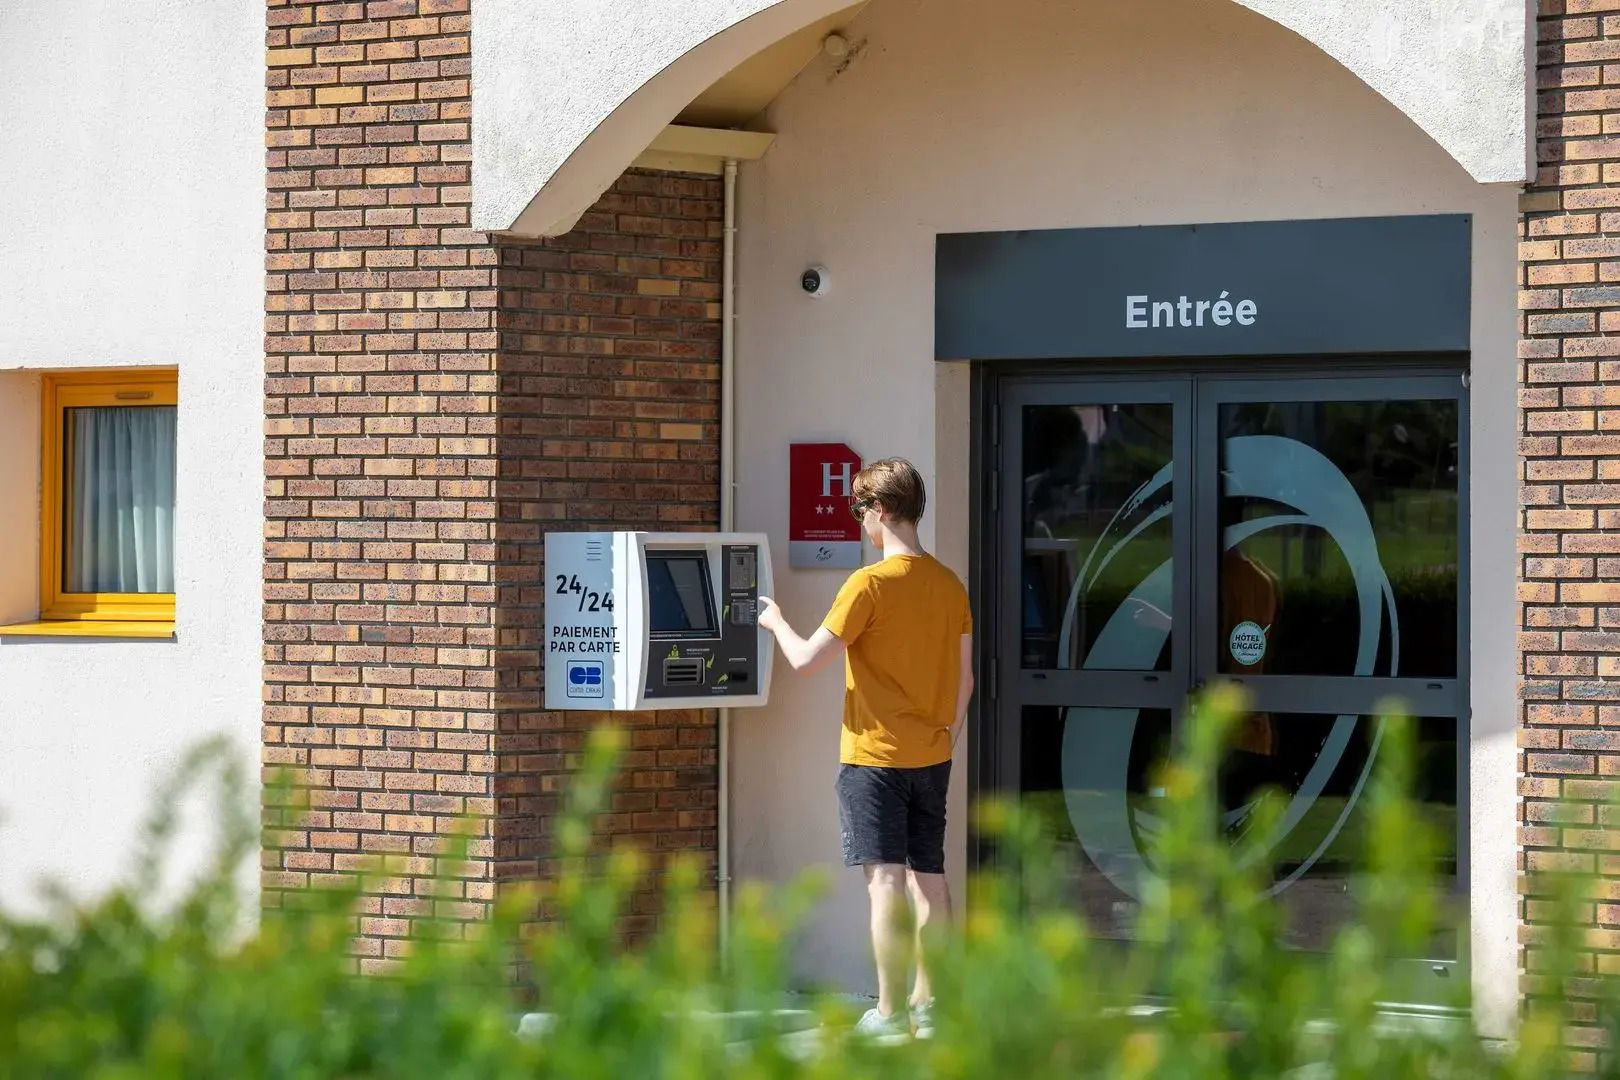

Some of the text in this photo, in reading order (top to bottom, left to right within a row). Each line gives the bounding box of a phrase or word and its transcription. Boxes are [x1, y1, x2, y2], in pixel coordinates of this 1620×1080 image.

[1126, 290, 1257, 328] Entrée
[820, 462, 853, 497] H
[556, 574, 614, 612] 24/24
[553, 626, 618, 638] PAIEMENT
[1235, 633, 1260, 641] HÔTEL
[550, 641, 621, 653] PAR CARTE
[569, 667, 601, 685] CB
